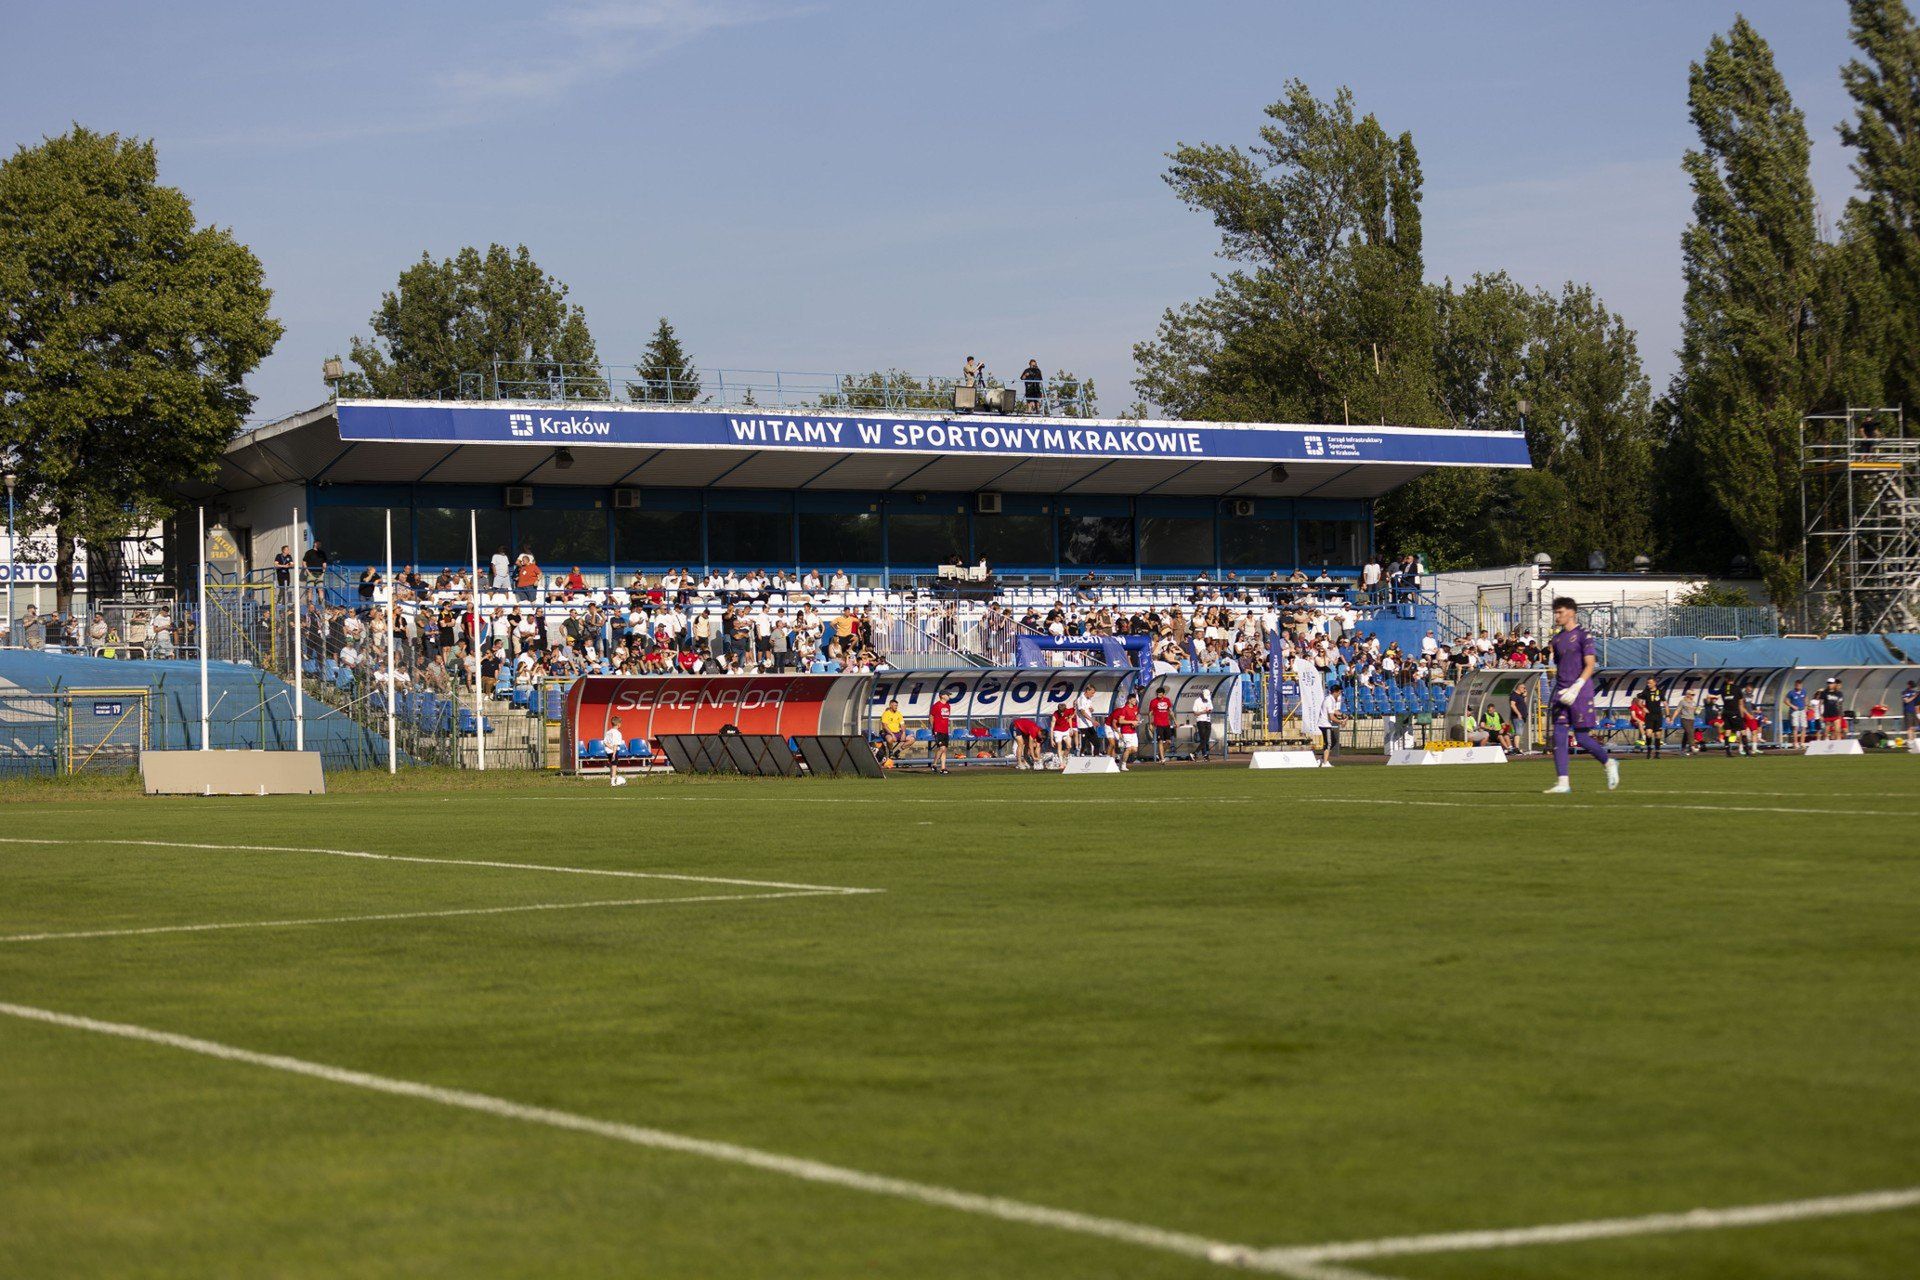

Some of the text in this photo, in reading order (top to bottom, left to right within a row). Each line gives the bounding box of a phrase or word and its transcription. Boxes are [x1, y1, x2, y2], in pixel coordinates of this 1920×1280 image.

[539, 416, 610, 436] Kraków
[731, 419, 1204, 453] WITAMY W SPORTOWYM KRAKOWIE
[1345, 436, 1383, 444] Infrastruktury
[0, 564, 86, 581] ORTOA
[616, 688, 784, 711] SERENADA
